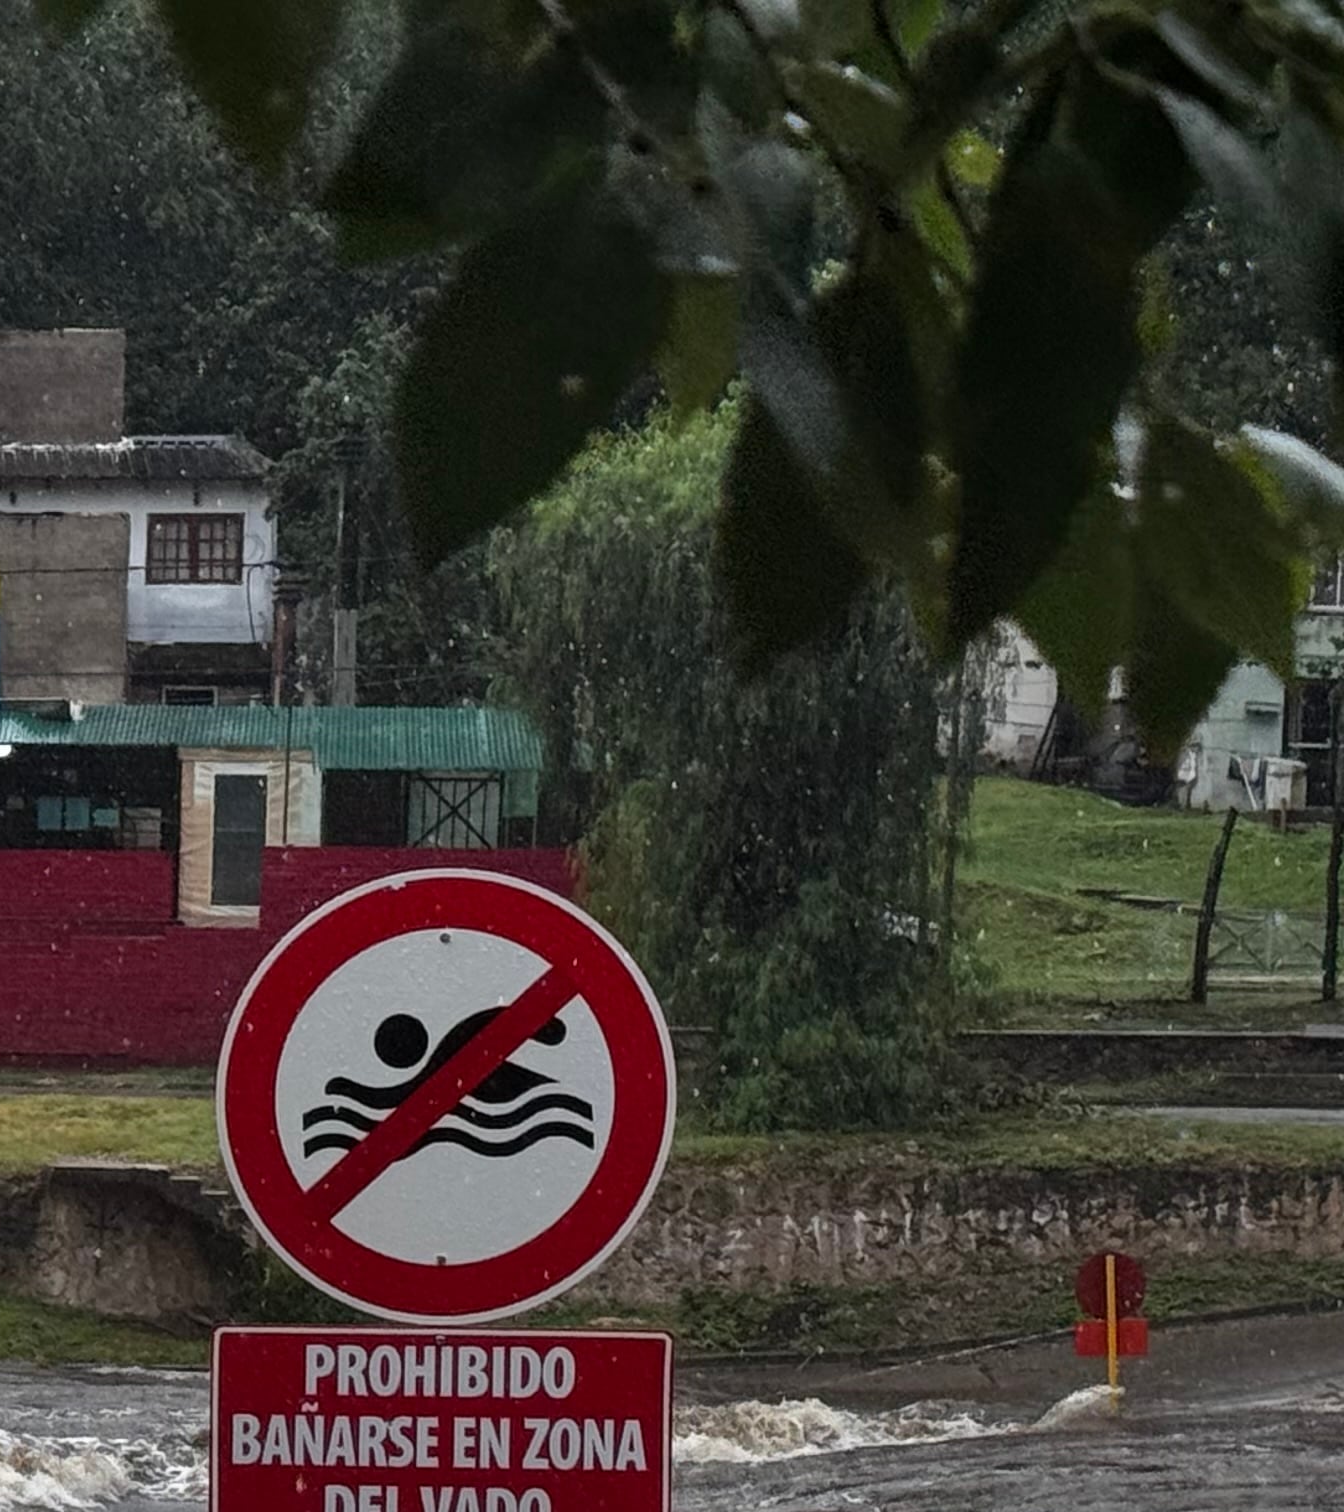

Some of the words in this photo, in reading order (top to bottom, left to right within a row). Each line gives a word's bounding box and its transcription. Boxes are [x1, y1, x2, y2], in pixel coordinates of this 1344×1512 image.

[305, 1344, 575, 1399] PROHIBIDO
[232, 1402, 439, 1468] BAÑARSE
[453, 1417, 511, 1469] EN
[522, 1418, 648, 1472] ZONA
